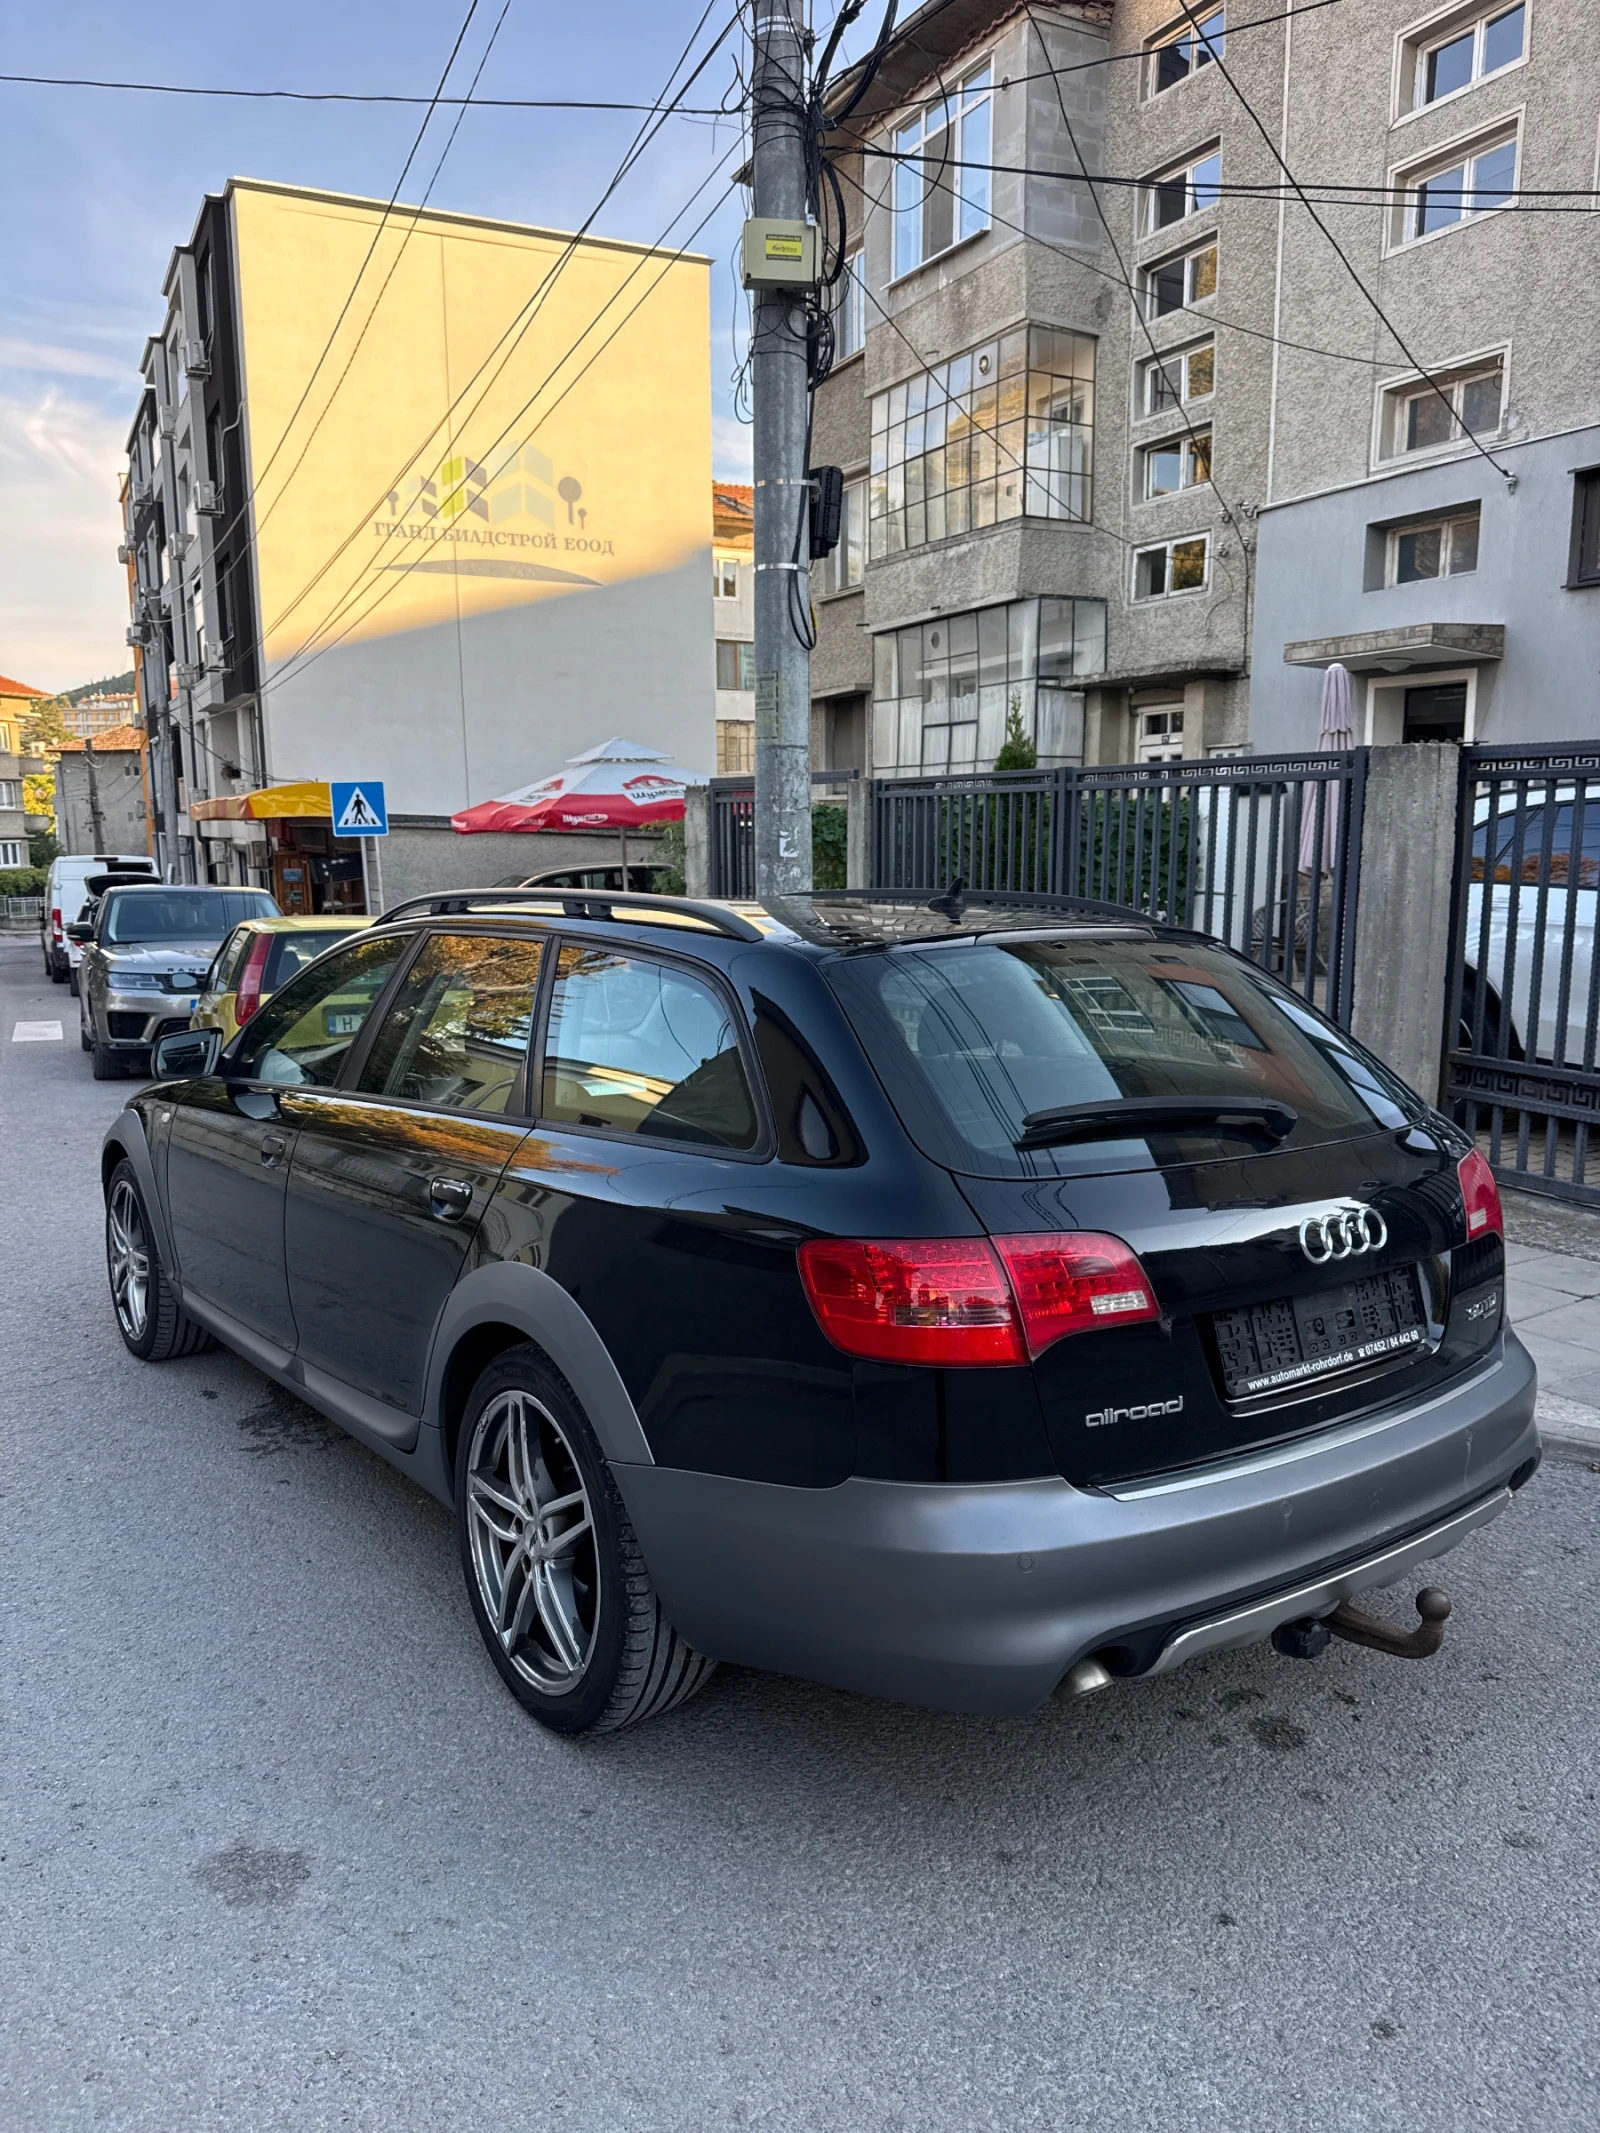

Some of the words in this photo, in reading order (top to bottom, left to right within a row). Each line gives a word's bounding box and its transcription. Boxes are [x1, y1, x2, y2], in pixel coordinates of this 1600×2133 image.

[374, 521, 436, 541] ГРАНД
[443, 527, 558, 549] БИЛДСТРОЙ
[564, 537, 614, 556] ЕООД
[1247, 1352, 1354, 1391] www.automarkt-rohrdorf.de
[1365, 1340, 1387, 1356] 07452
[1390, 1336, 1399, 1347] 84
[1399, 1332, 1410, 1344] 442
[1085, 1395, 1184, 1428] allroad
